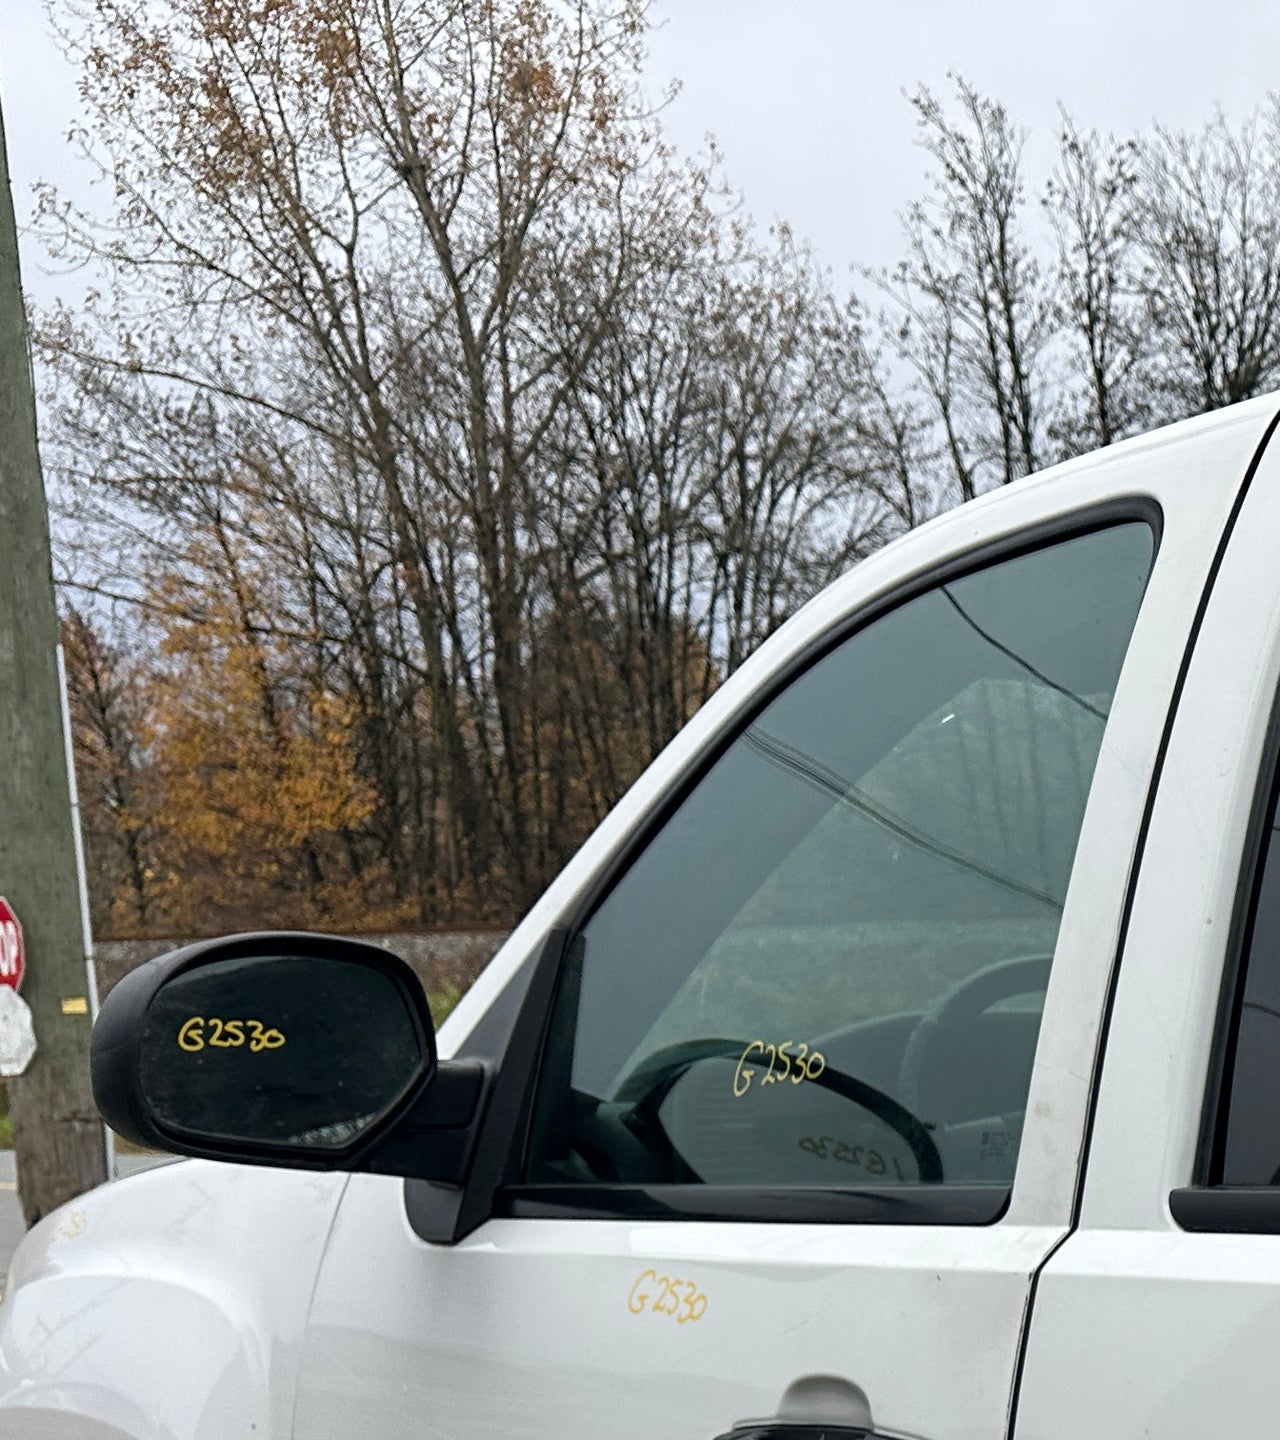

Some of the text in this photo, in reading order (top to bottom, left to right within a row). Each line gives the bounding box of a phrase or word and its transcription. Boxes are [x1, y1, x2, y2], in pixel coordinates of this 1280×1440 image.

[177, 1016, 287, 1052] G2530
[733, 1040, 826, 1098] G2530
[627, 1268, 709, 1325] G2530
